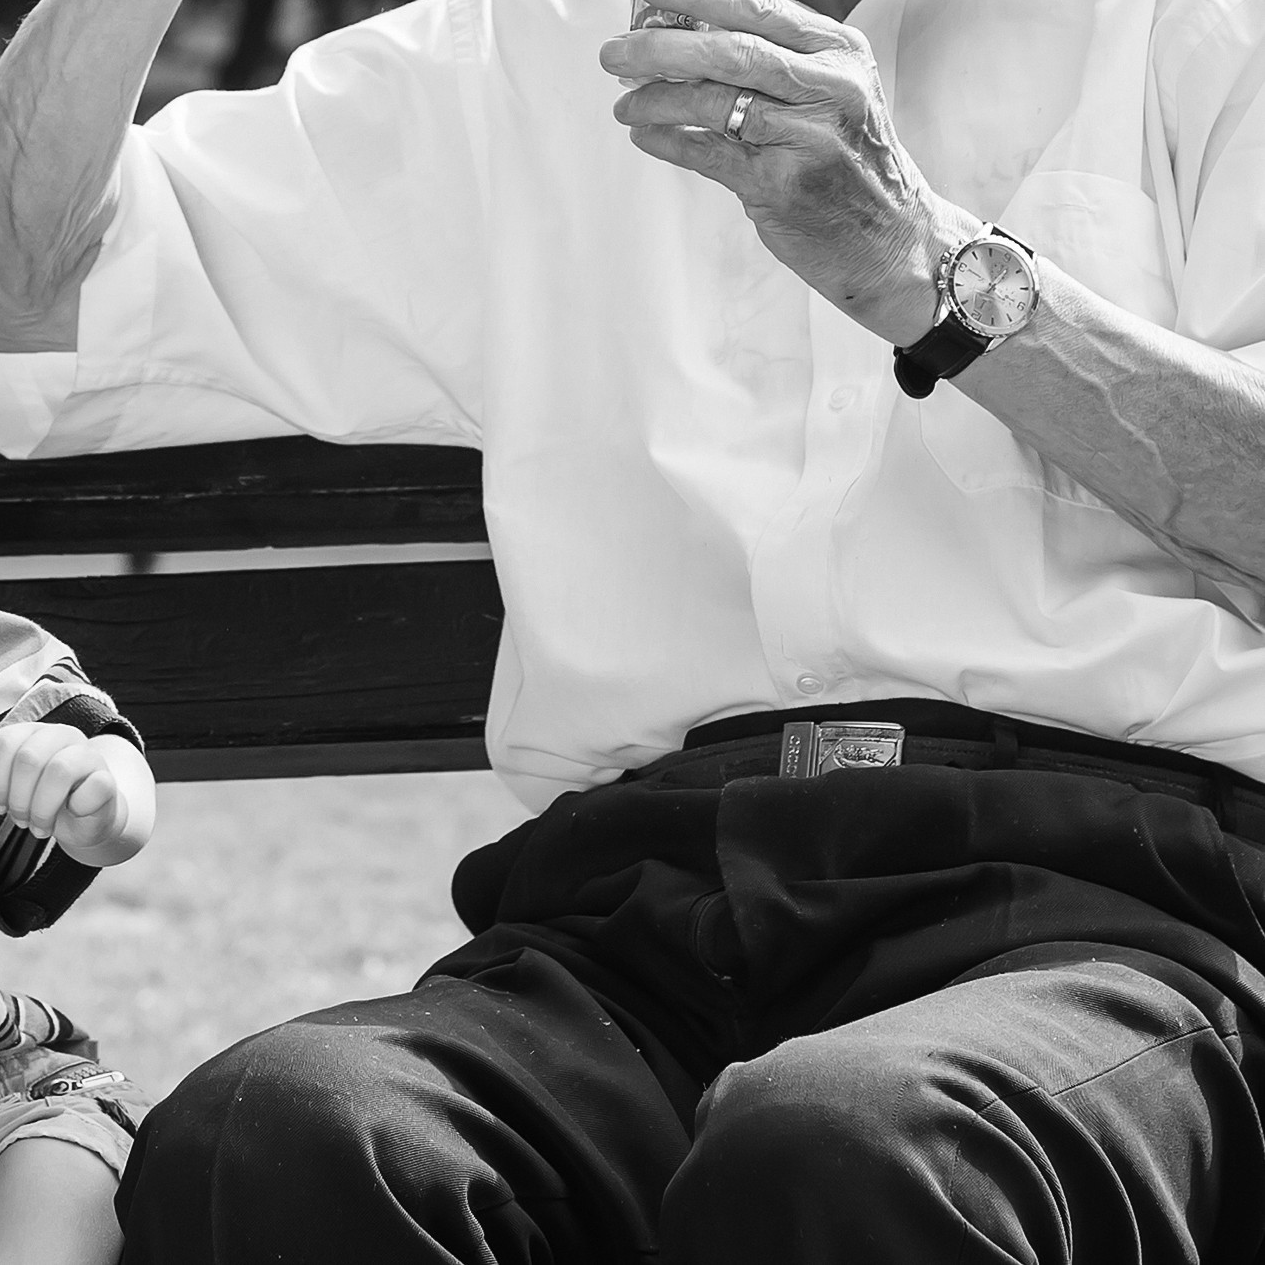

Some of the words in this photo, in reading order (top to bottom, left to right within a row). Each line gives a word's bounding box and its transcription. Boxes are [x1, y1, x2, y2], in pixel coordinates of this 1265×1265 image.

[676, 13, 692, 27] CE
[958, 262, 967, 272] 3
[1016, 301, 1026, 311] 9
[971, 309, 982, 321] 12
